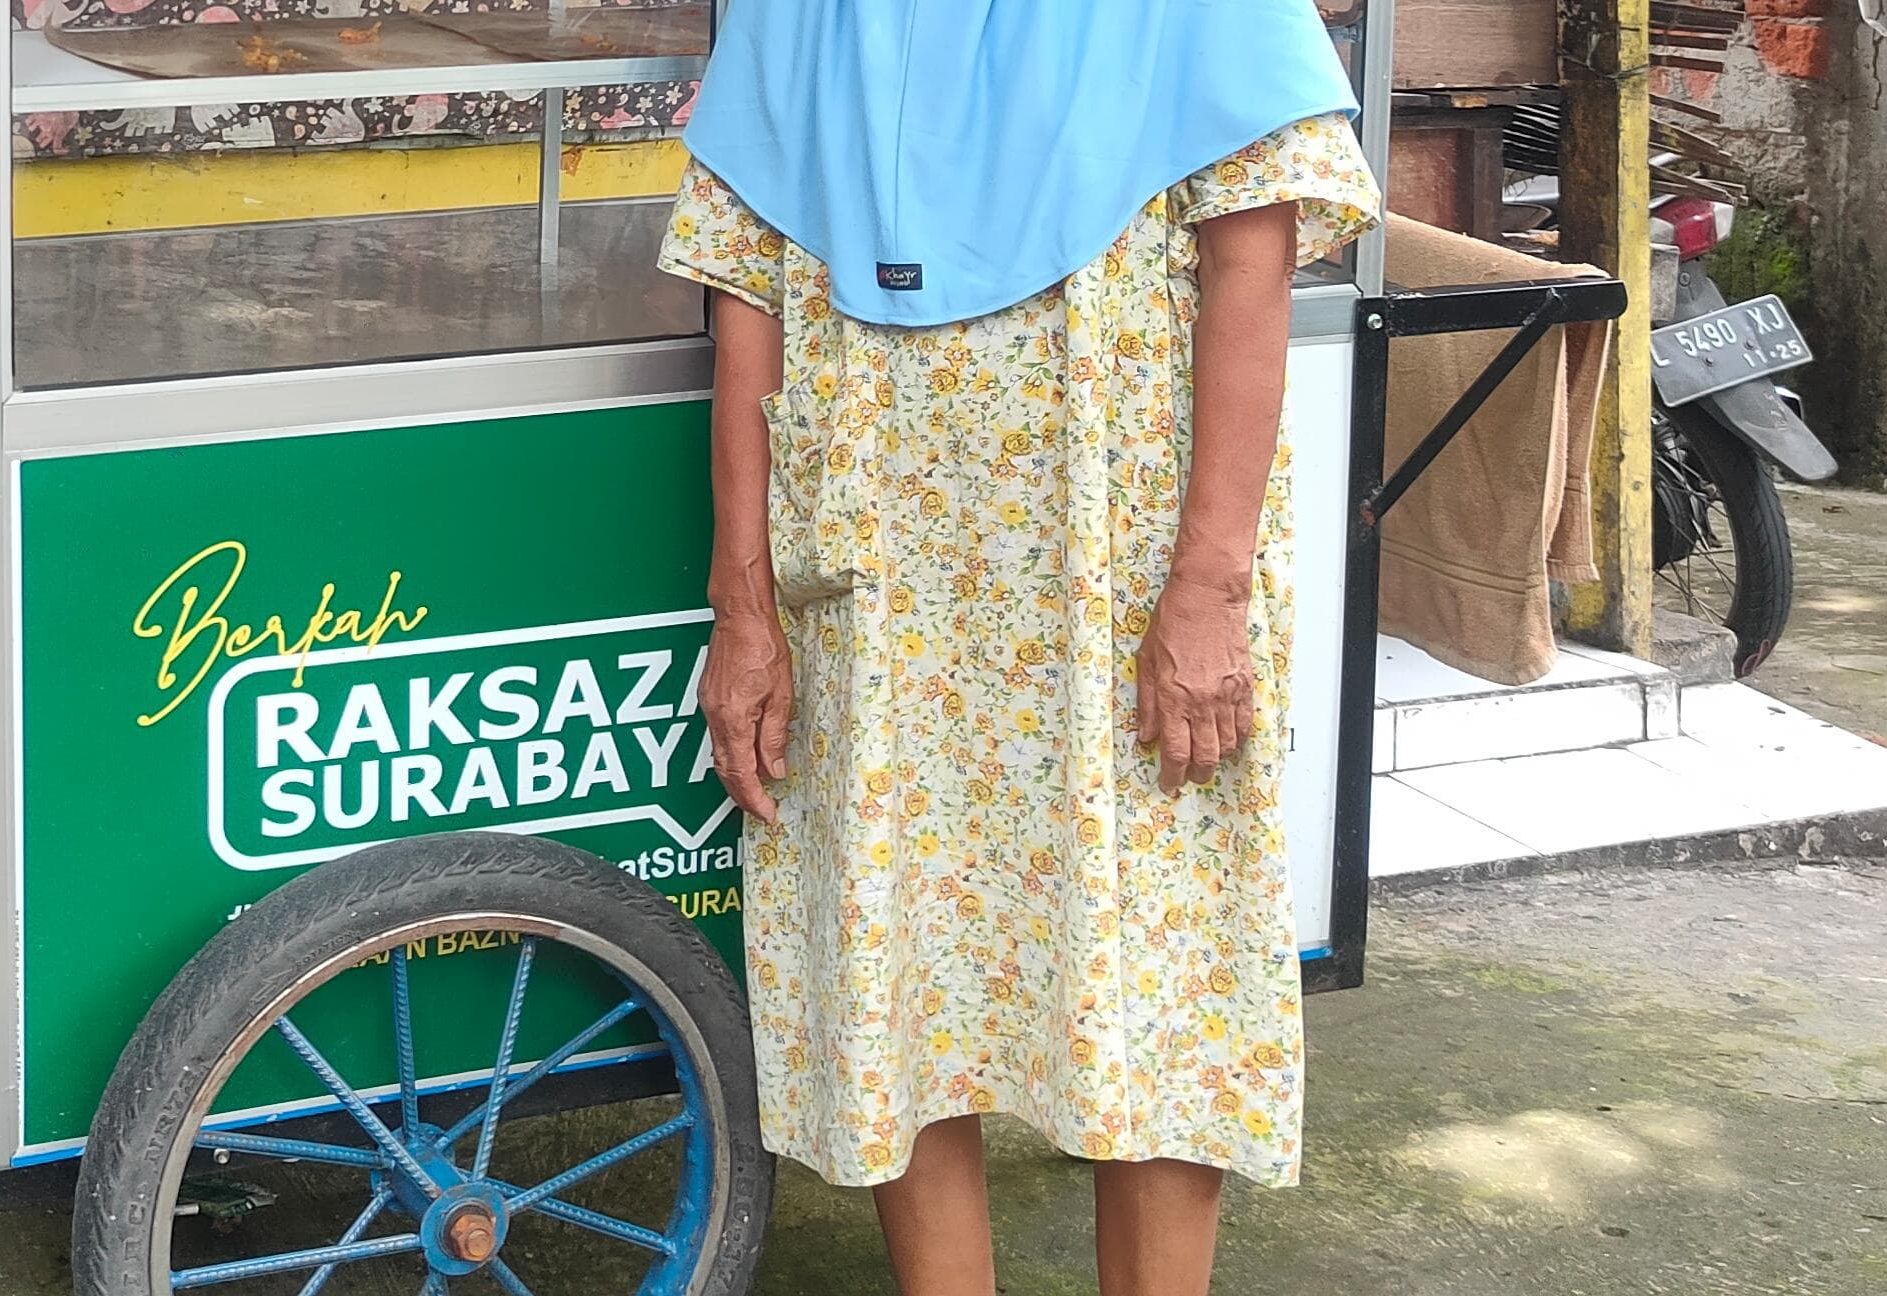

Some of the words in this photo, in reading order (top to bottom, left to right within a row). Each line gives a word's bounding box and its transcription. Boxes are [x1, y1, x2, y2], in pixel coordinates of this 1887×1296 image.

[1651, 347, 1671, 367] L
[1674, 318, 1738, 357] 5490
[1747, 304, 1785, 335] XJ
[133, 540, 428, 727] Berkah
